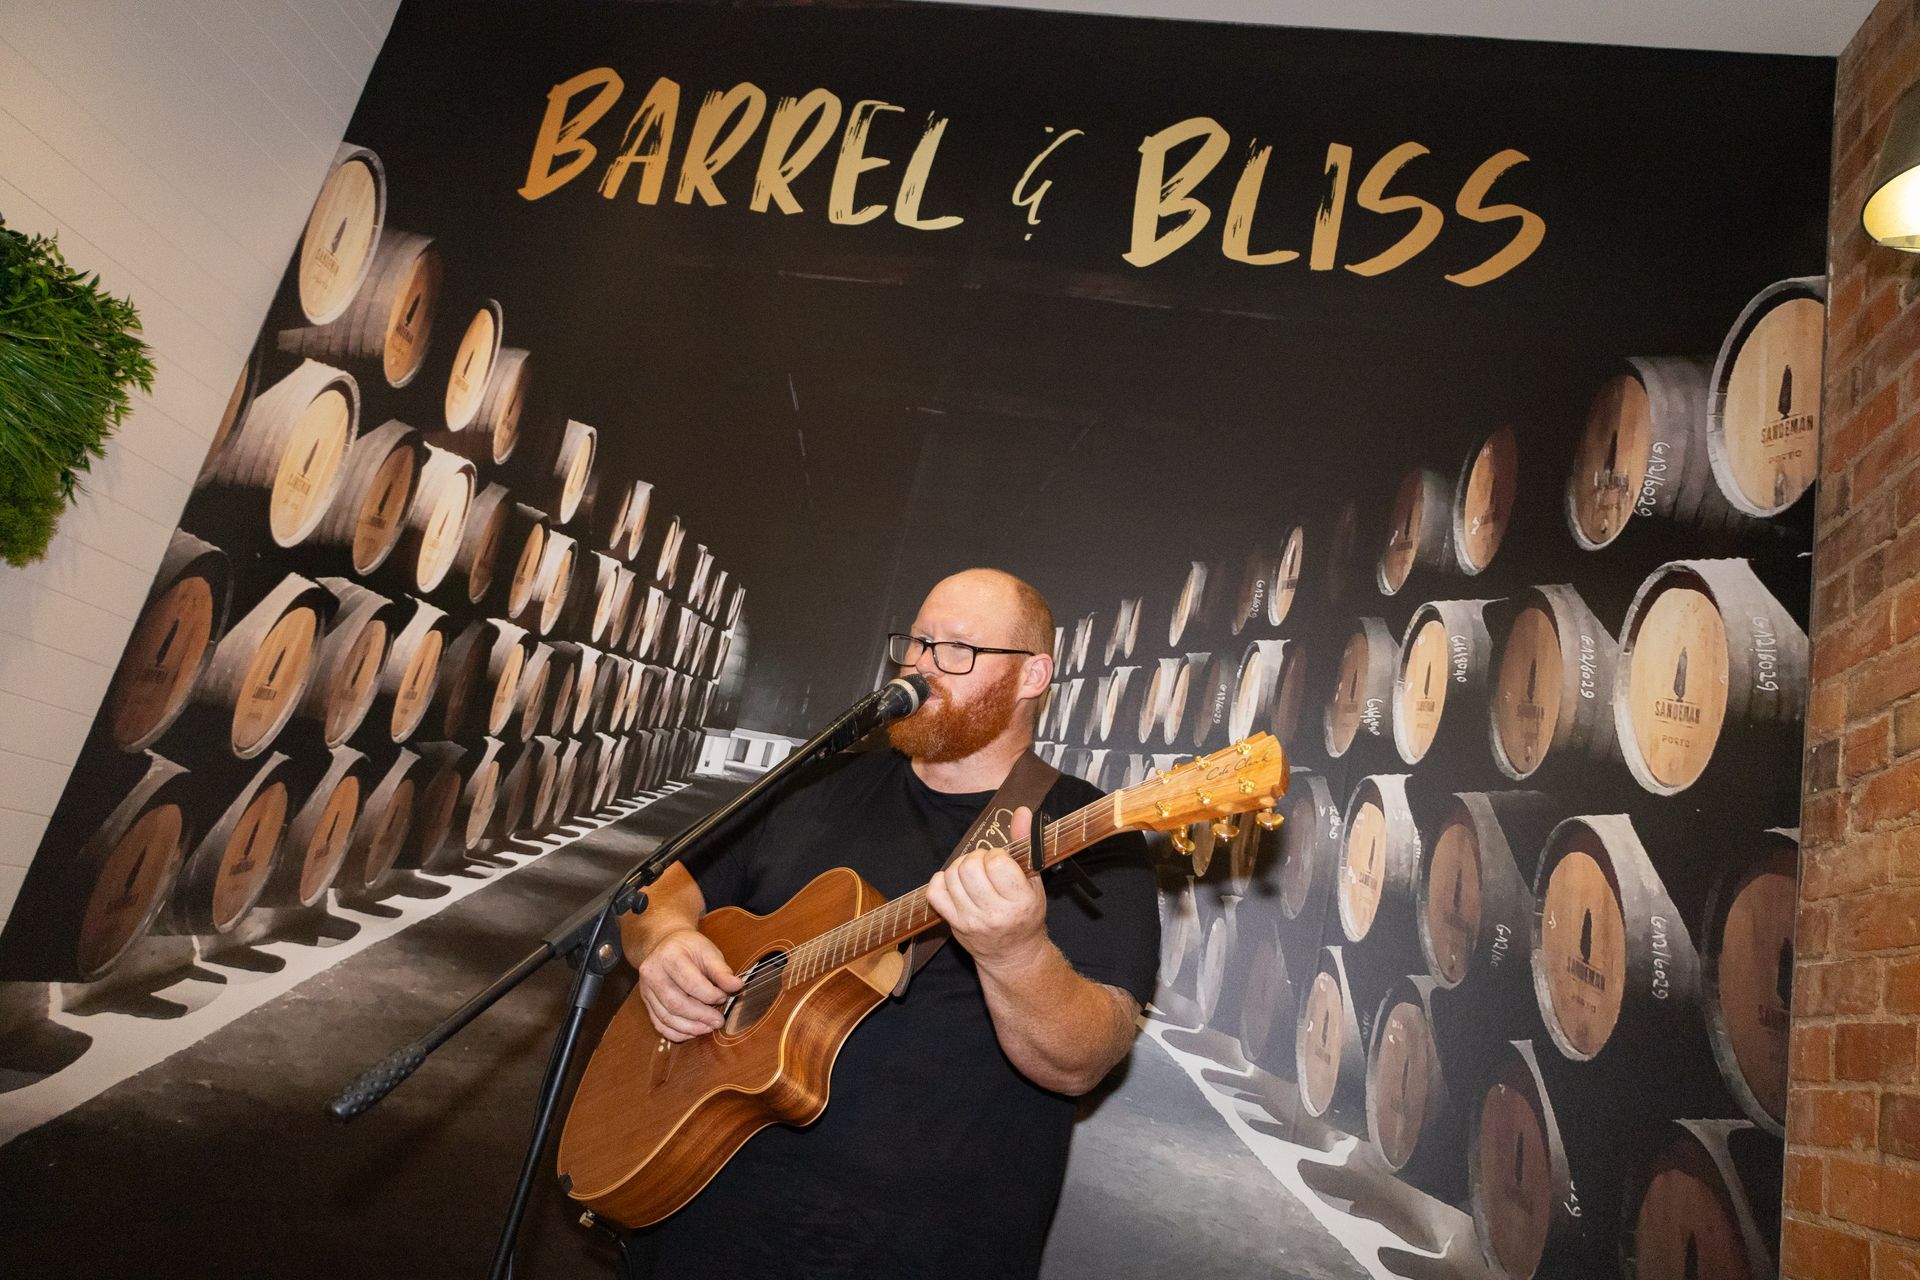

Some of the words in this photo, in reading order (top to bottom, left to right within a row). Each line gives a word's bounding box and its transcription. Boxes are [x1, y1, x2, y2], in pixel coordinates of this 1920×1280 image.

[517, 67, 964, 230] BARREL
[1121, 116, 1547, 287] BLISS
[1760, 414, 1814, 444] SANDEMAN
[1655, 700, 1701, 725] SANDEMAN
